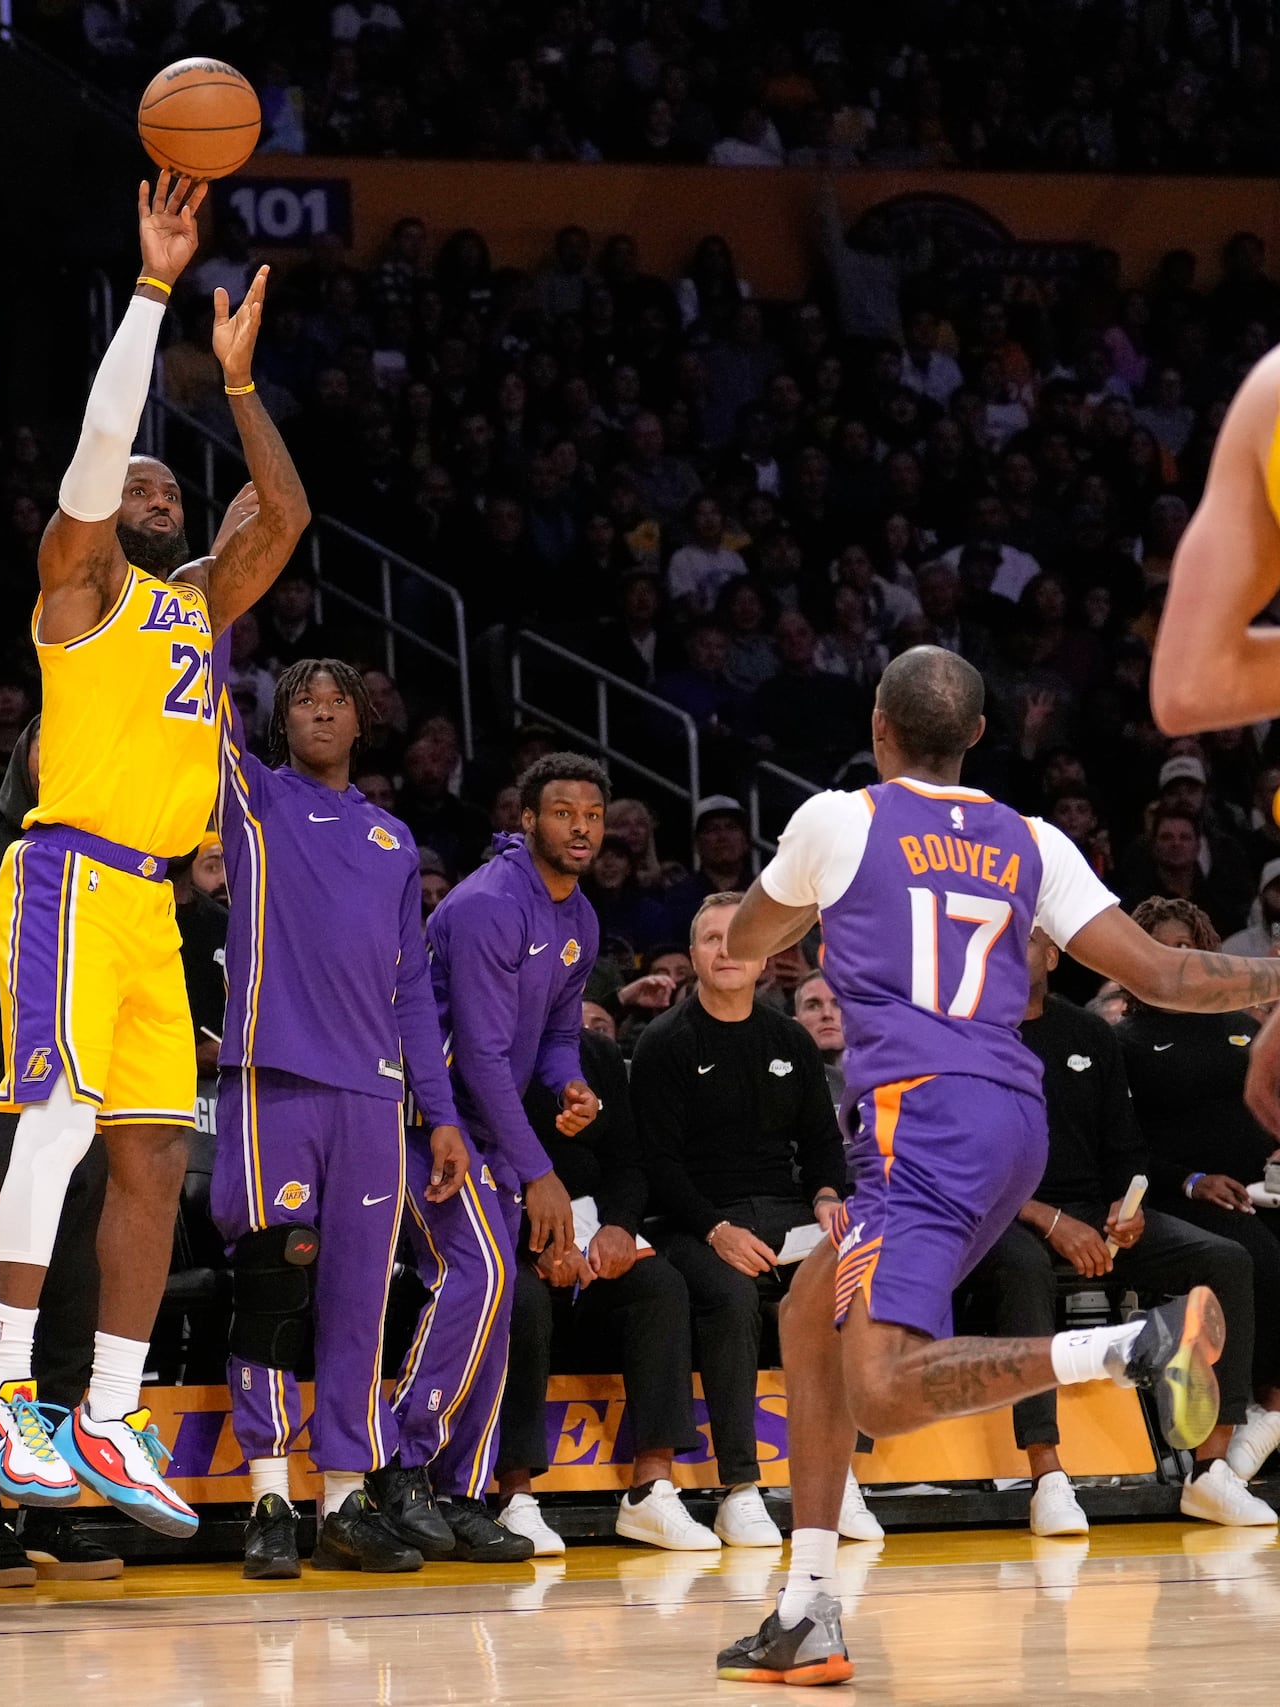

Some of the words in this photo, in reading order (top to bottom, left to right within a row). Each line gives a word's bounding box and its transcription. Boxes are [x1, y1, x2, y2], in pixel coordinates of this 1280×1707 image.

[229, 187, 328, 237] 101
[899, 834, 1020, 894] BOUYEA
[907, 887, 1013, 1019] 17
